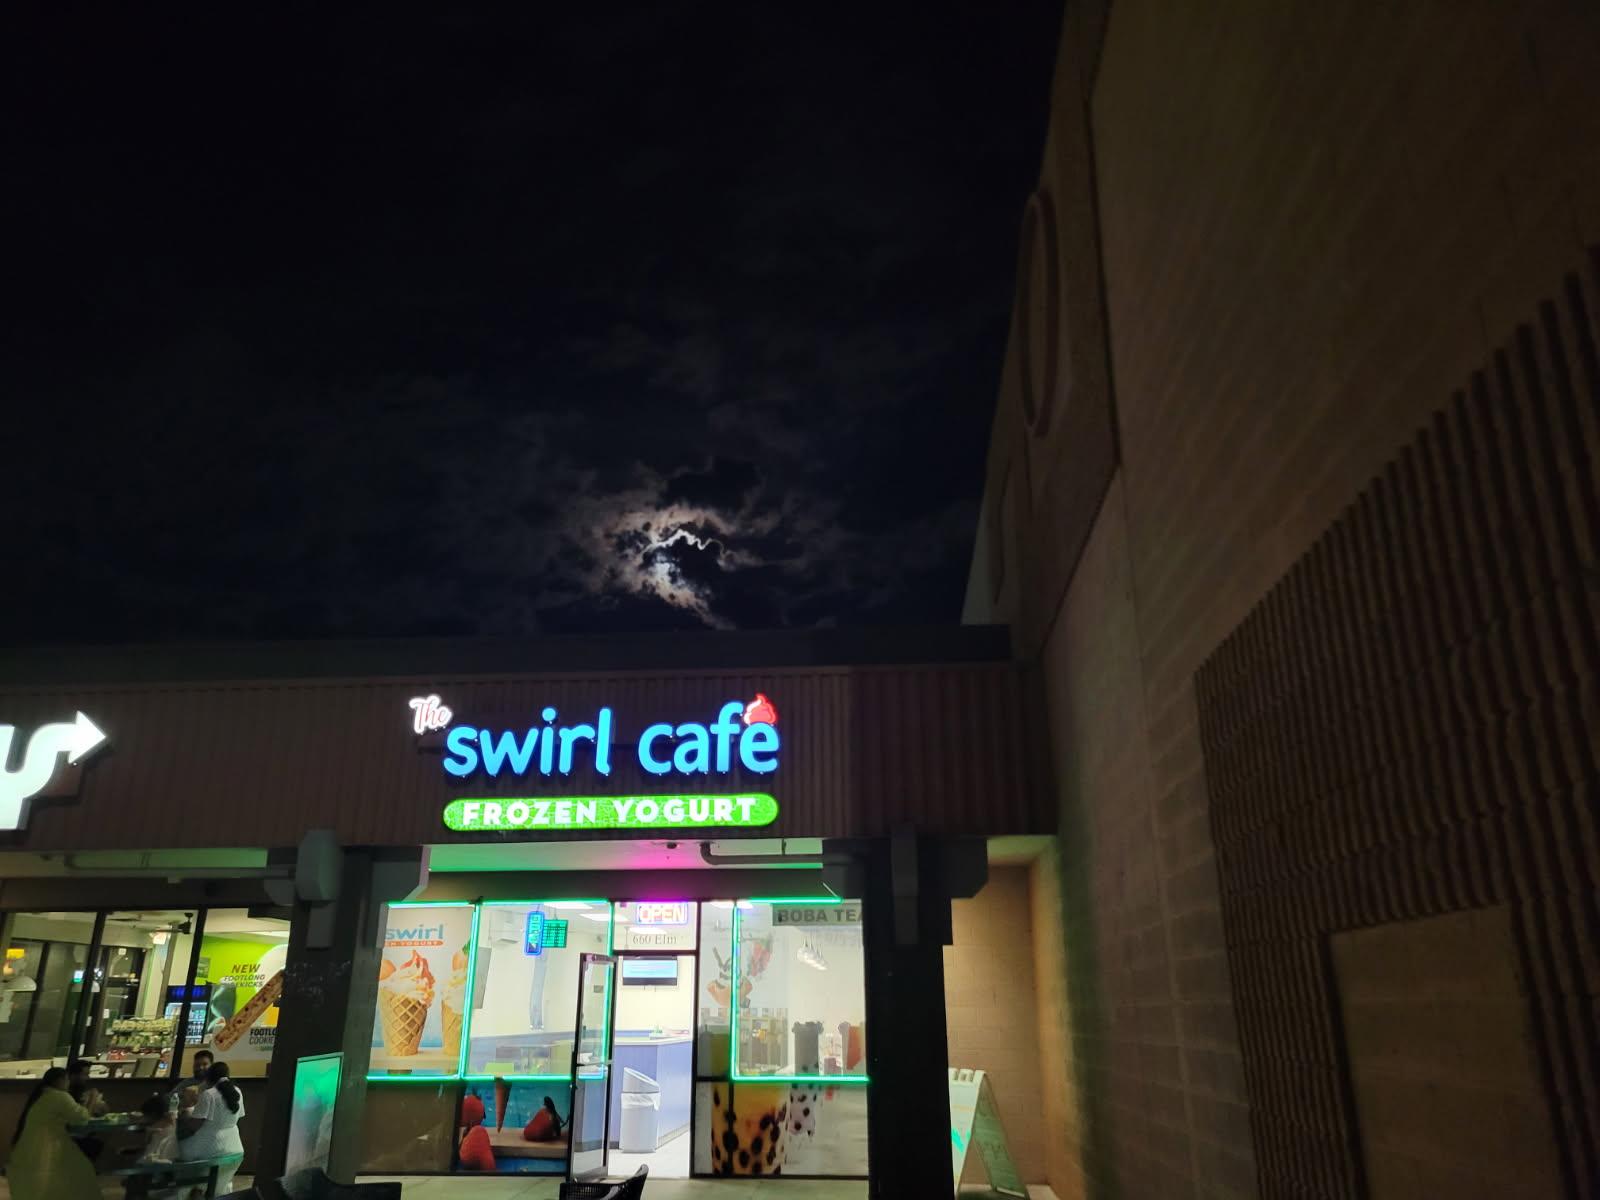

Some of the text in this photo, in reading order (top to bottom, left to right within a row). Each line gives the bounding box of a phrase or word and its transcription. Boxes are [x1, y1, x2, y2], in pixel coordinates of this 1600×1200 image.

[410, 695, 452, 733] The
[443, 707, 612, 776] swirl
[463, 798, 756, 826] FROZEN YOGURT
[639, 903, 684, 922] OPEN
[780, 909, 828, 922] BOBA
[633, 933, 677, 944] 660 Elm
[231, 964, 261, 973] NEW
